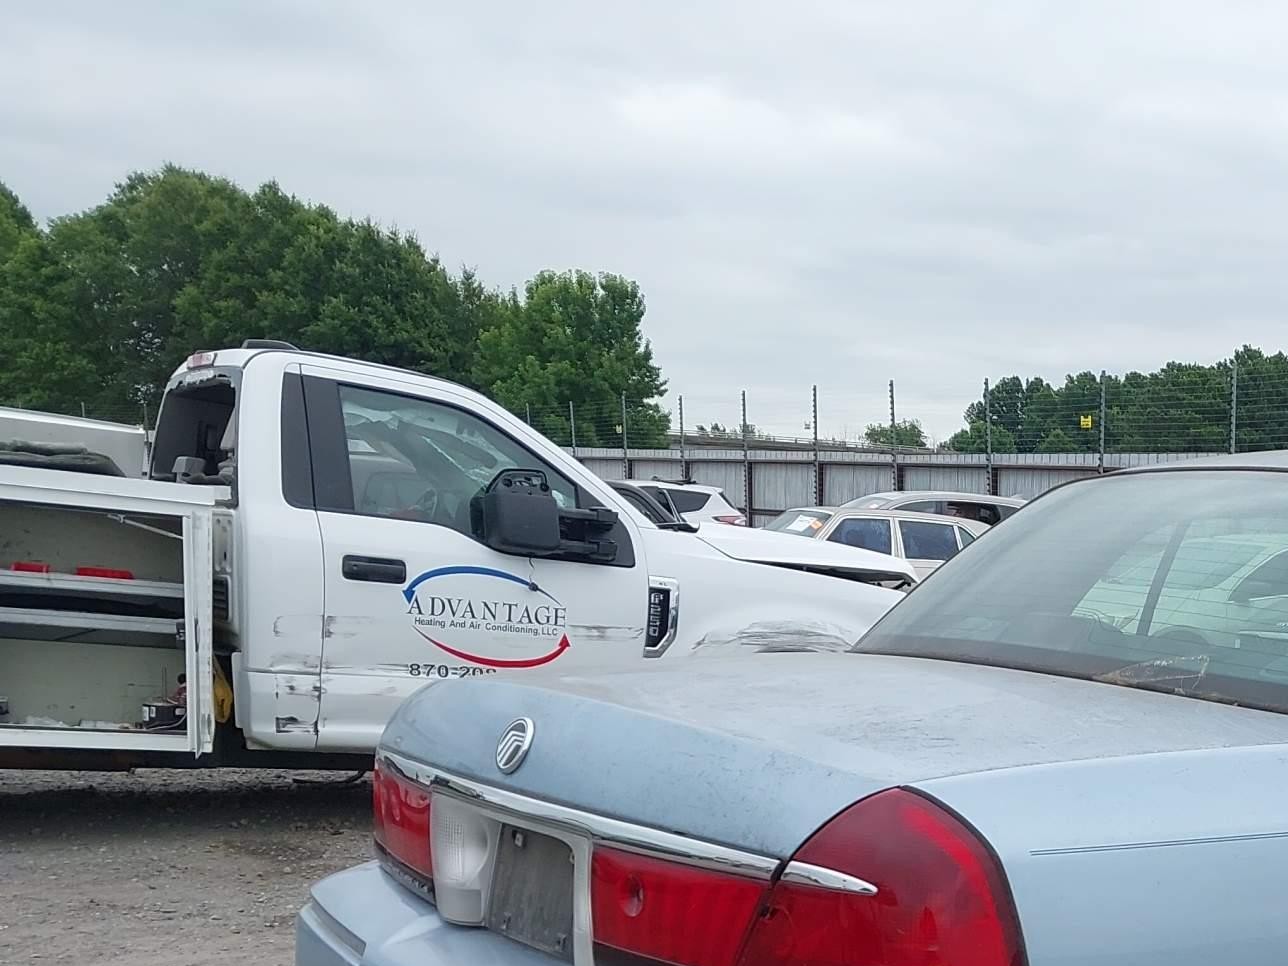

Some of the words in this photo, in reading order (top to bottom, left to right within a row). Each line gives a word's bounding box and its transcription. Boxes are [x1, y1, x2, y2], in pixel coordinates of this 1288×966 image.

[406, 594, 567, 628] ADVANTAGE
[414, 616, 446, 629] Heating
[448, 619, 466, 629] And
[468, 621, 481, 630] Air
[485, 622, 541, 636] Conditioning,
[541, 627, 559, 637] LLC
